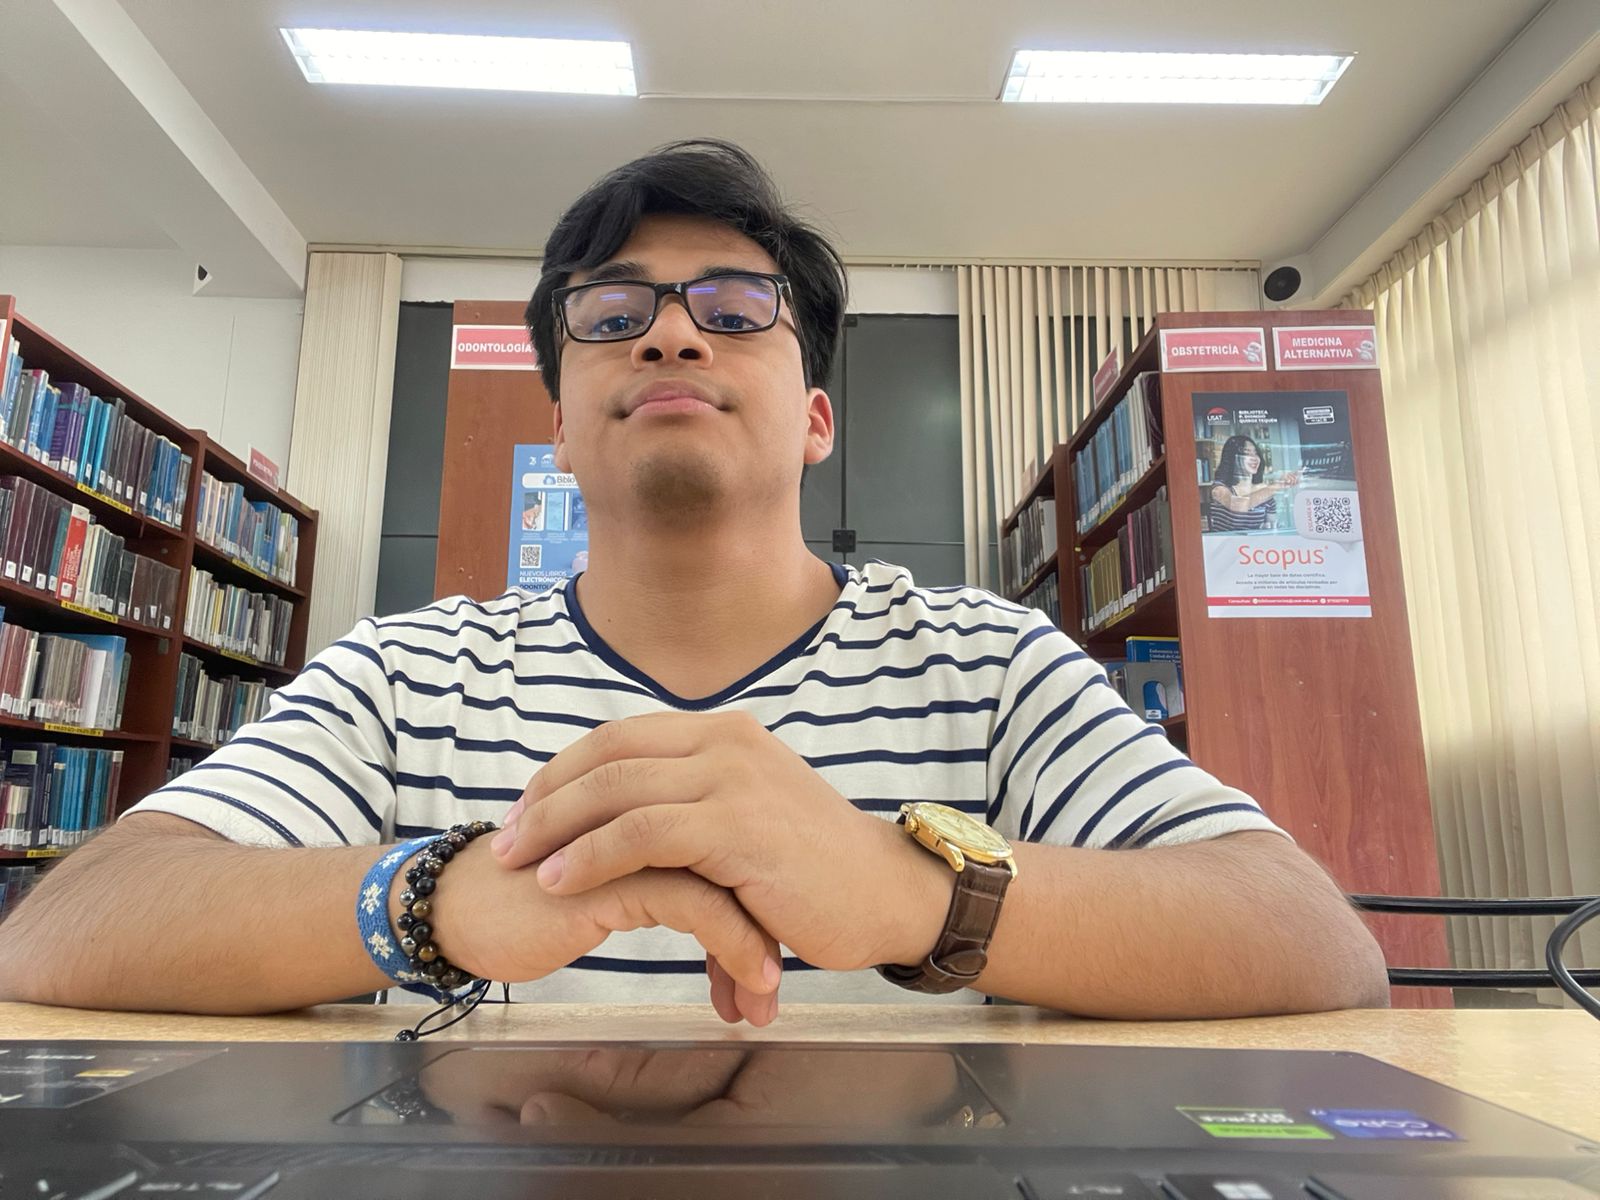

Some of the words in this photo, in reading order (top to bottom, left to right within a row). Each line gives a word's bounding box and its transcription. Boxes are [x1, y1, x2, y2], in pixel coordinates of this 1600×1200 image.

[457, 342, 532, 353] ODONTOLOGÍA
[1292, 337, 1342, 347] MEDICINA
[1171, 343, 1239, 357] OBSTETRICÍA
[1284, 348, 1353, 359] ALTERNATIVA
[556, 475, 576, 483] Biblio
